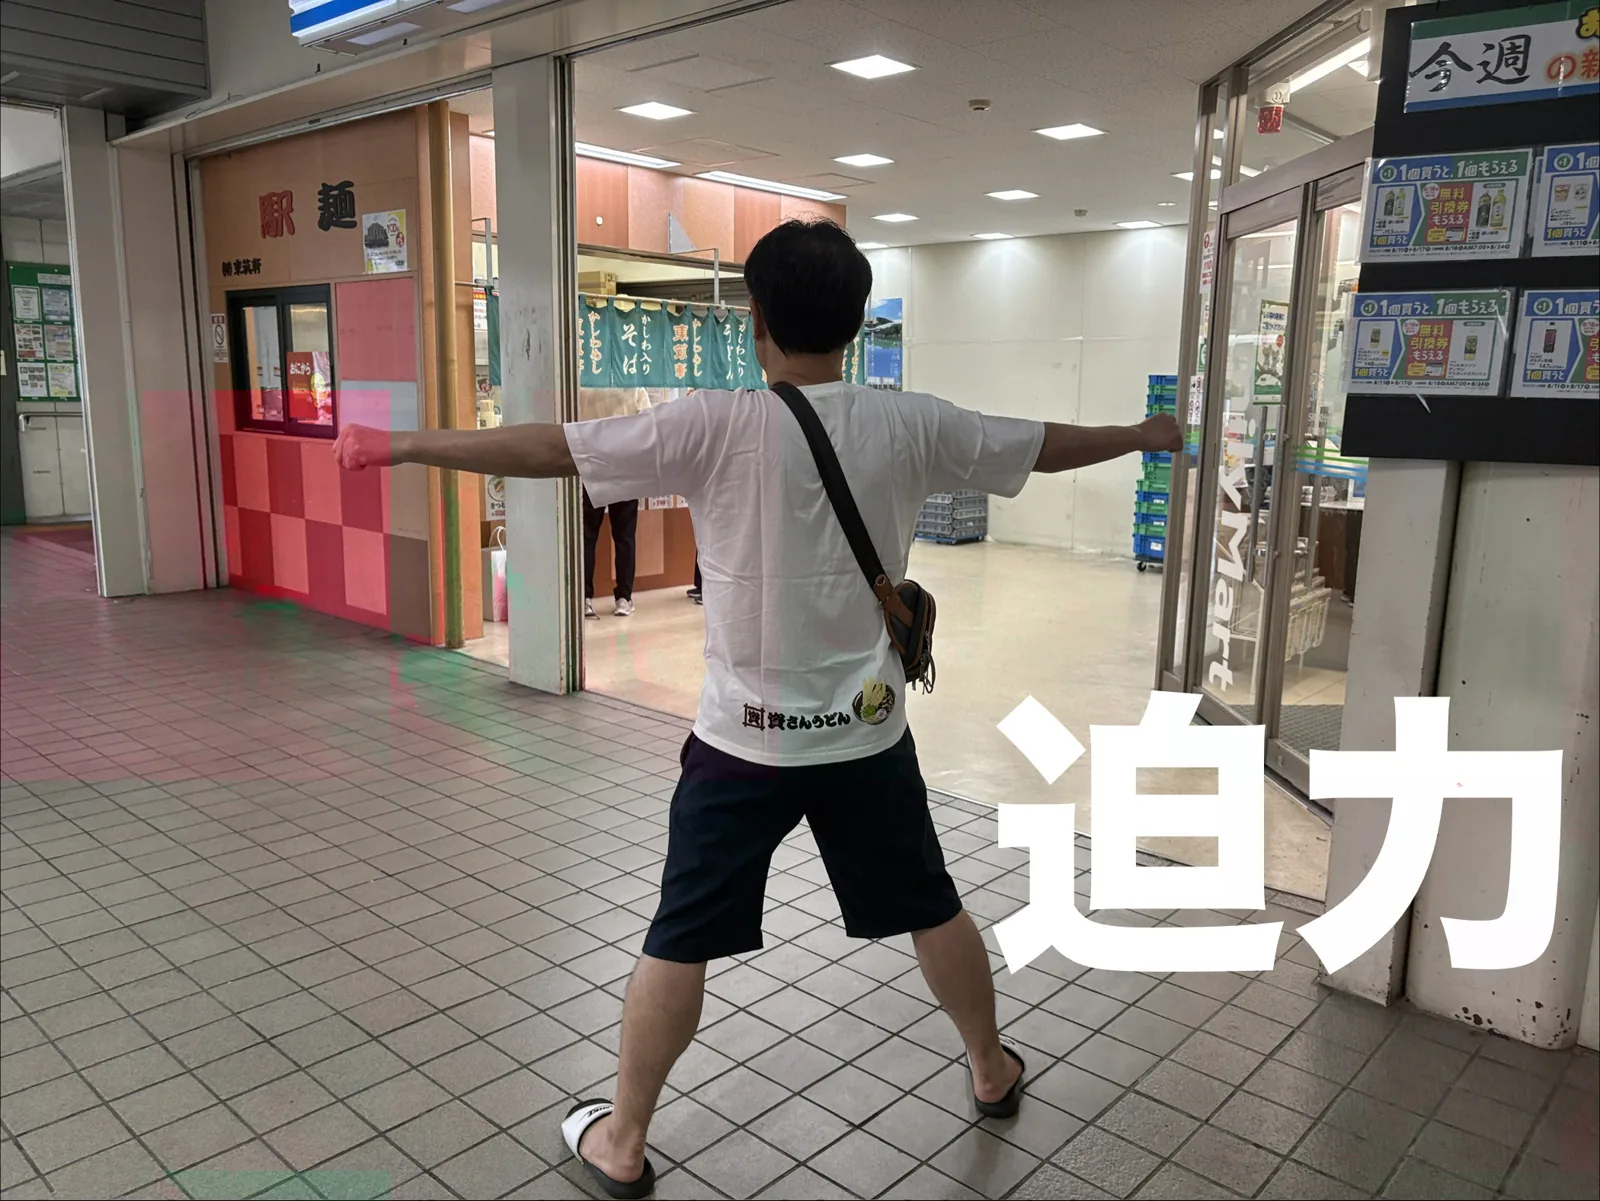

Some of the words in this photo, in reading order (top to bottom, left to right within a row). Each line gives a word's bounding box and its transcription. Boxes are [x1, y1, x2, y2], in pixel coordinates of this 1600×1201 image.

[1440, 187, 1465, 201] 無料
[1432, 214, 1465, 225] もらえる
[1546, 227, 1586, 239] 1個買うと
[1372, 235, 1409, 246] 1個買うと
[1420, 323, 1444, 337] 無料
[621, 323, 638, 376] そば
[640, 314, 653, 376] かしわ入り
[1412, 350, 1444, 361] もらえる
[1354, 367, 1389, 377] 1個買うと
[1526, 370, 1565, 381] 1個買うと
[767, 712, 851, 731] 資さんうどん
